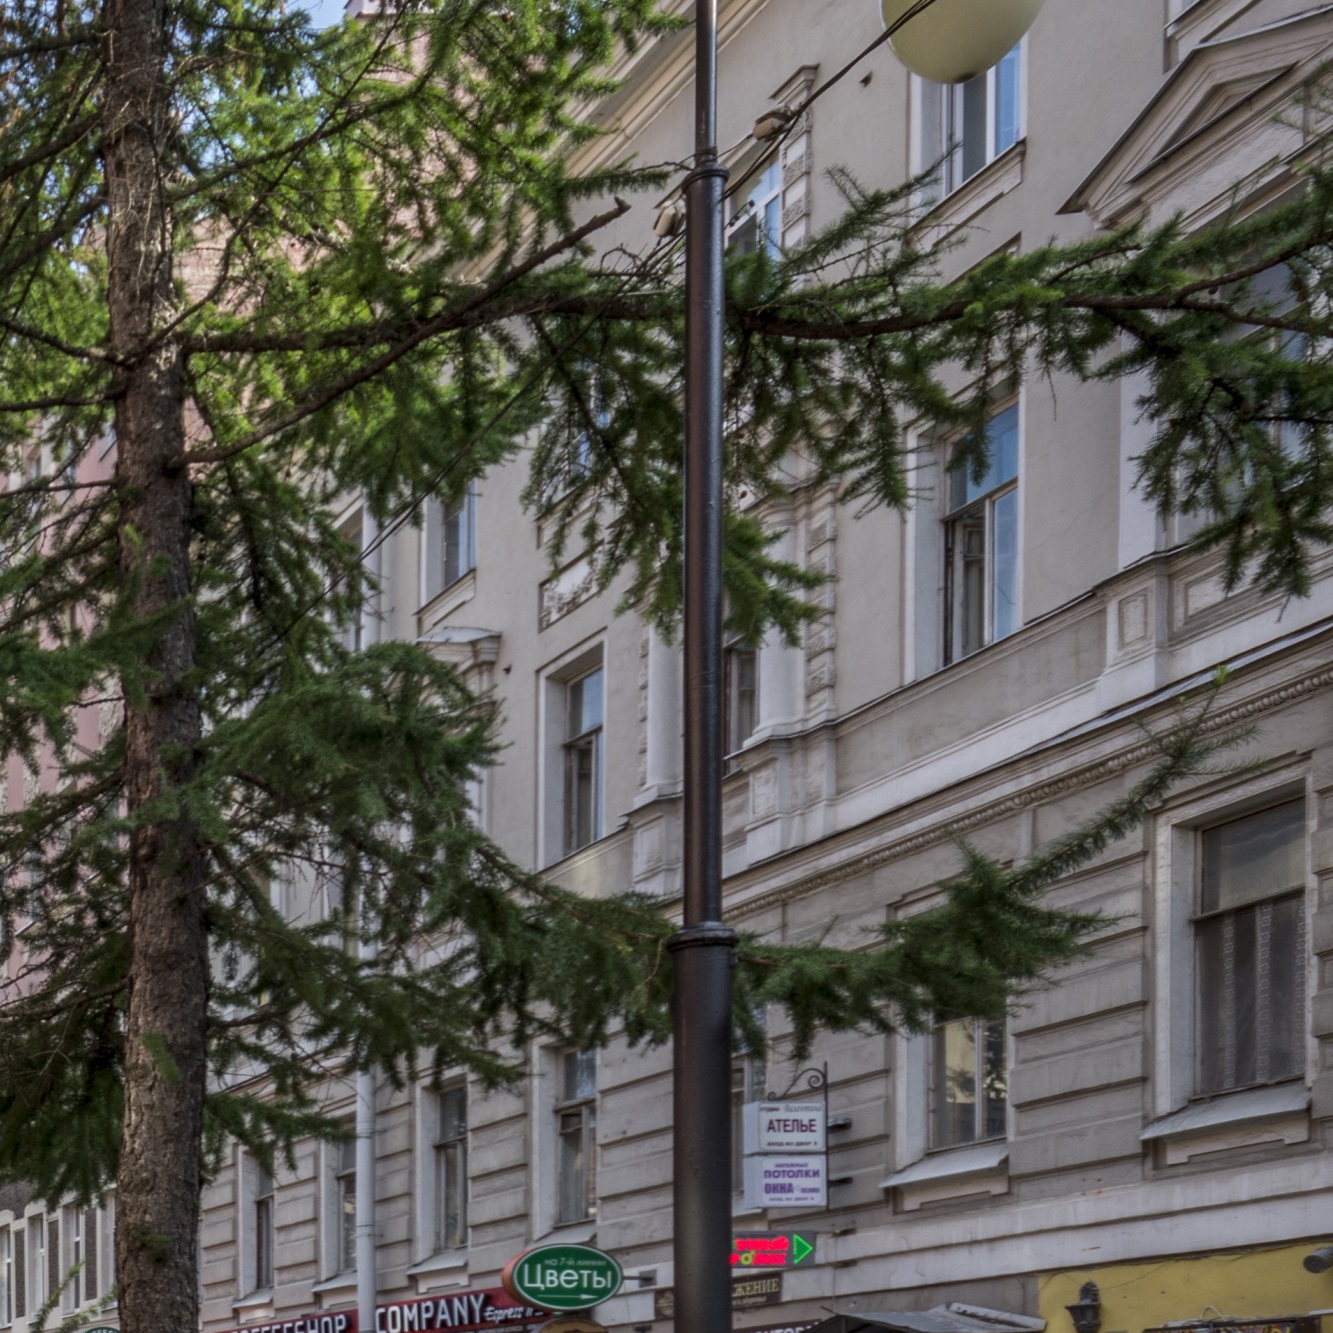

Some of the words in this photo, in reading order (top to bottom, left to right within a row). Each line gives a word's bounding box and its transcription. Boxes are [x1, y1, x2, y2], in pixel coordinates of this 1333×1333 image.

[767, 1119, 817, 1132] АТЕЛЬЕ
[764, 1170, 820, 1178] ПОТОЛКИ
[765, 1183, 793, 1194] ОКНА
[523, 1264, 611, 1291] Цветы
[732, 1278, 780, 1297] ЖЕНИЕ
